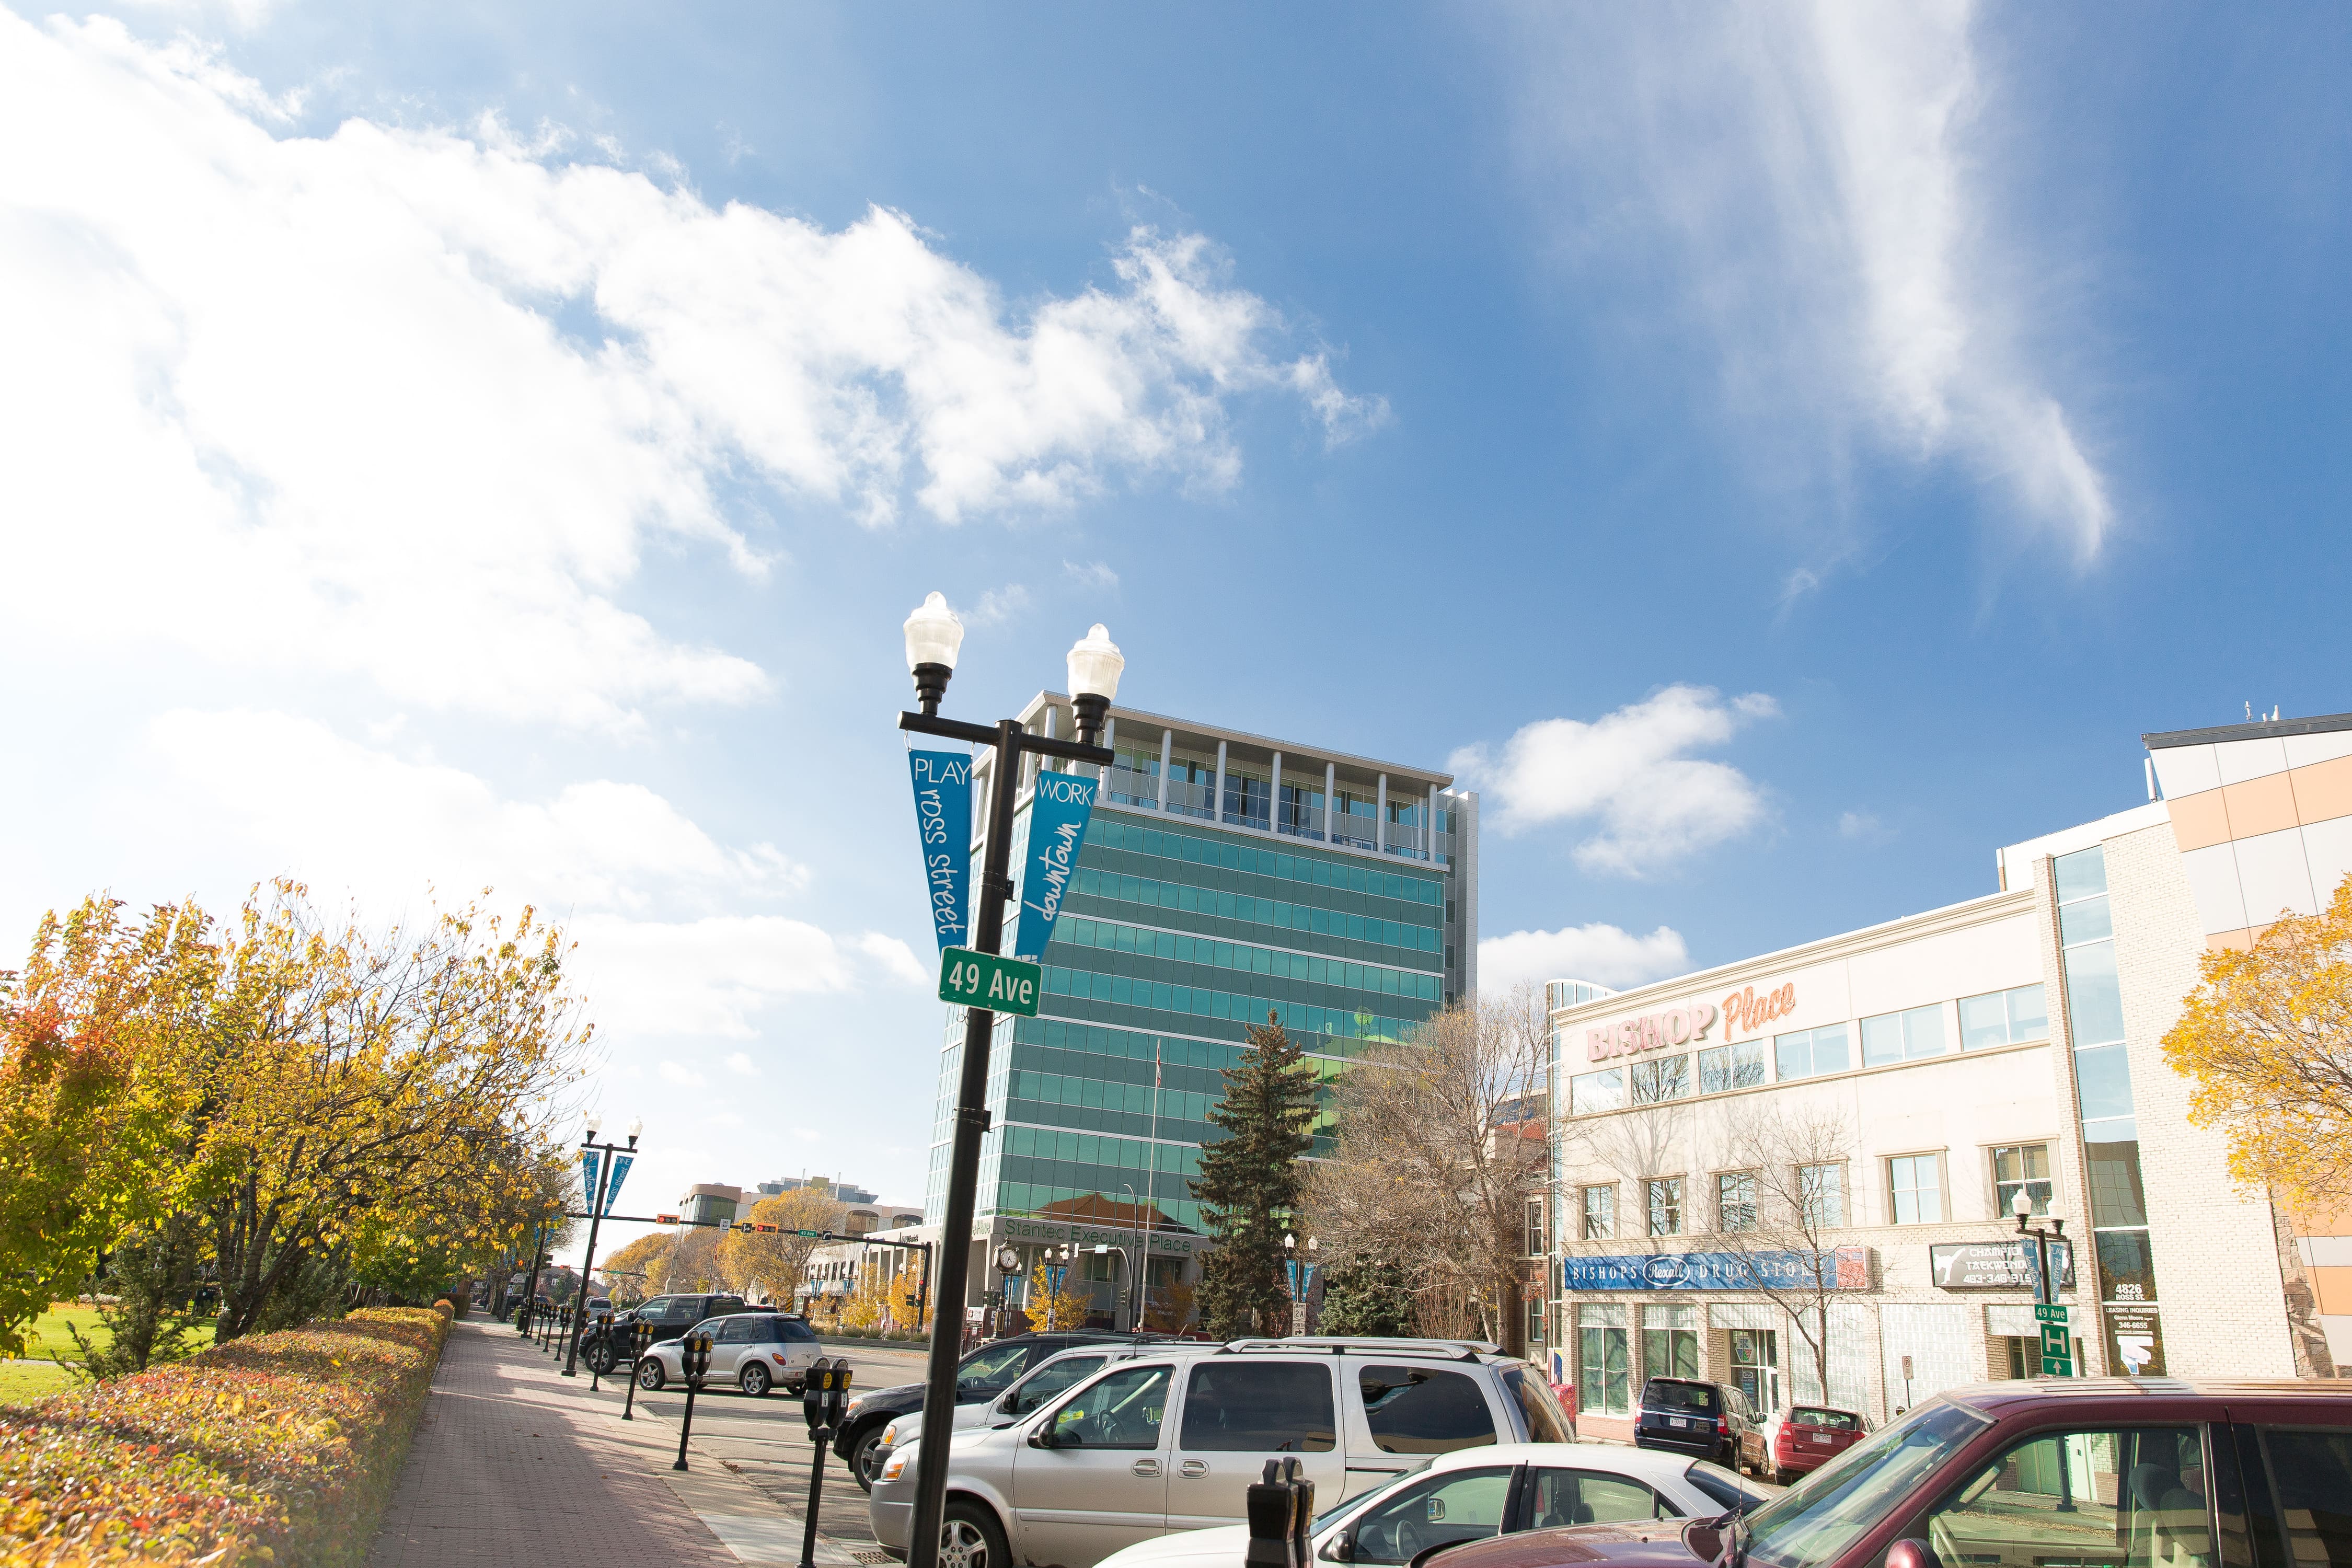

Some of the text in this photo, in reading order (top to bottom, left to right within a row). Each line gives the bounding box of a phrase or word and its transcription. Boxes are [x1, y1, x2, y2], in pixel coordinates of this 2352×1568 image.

[915, 758, 971, 785] PLAY
[1039, 777, 1093, 807] WORK
[920, 788, 965, 935] ross street
[1024, 821, 1081, 922] downtown
[949, 961, 1033, 1005] 49 Ave
[1586, 982, 1796, 1062] BISHOP Place
[616, 1157, 630, 1166] DINE
[608, 1166, 628, 1201] ross street
[1005, 1219, 1191, 1251] Stantec Executive Place
[1573, 1261, 1823, 1279] BISHOPS Rexall DRUG STOR
[1963, 1274, 2033, 1283] 403-340-915
[2115, 1283, 2142, 1295] 4826
[2037, 1308, 2065, 1319] 49 Ave
[2045, 1329, 2066, 1354] H
